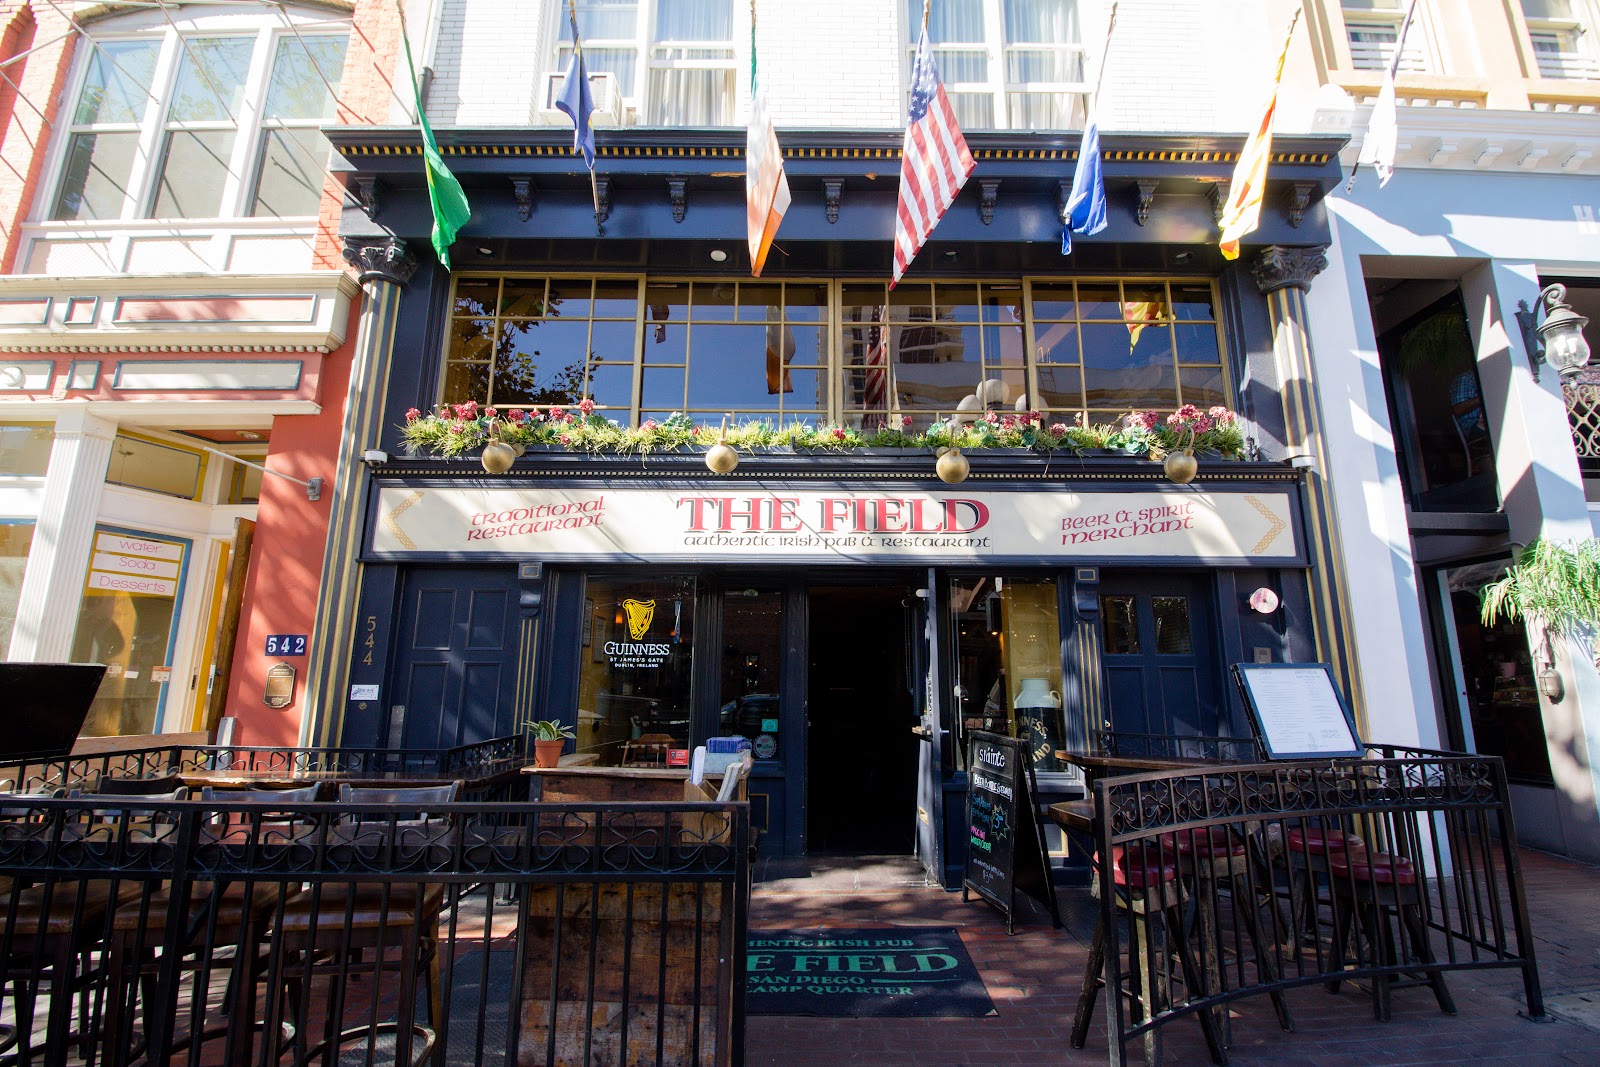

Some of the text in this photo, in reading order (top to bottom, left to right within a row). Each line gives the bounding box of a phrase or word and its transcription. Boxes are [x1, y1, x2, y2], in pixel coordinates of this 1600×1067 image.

[471, 496, 606, 526] traditional
[676, 497, 990, 535] THE FIELD
[1115, 510, 1133, 523] &
[467, 512, 605, 541] restaurant
[1061, 515, 1194, 545] merchant
[684, 534, 775, 547] authentic
[861, 536, 877, 547] &
[881, 536, 990, 548] restaurant
[118, 556, 156, 571] Soda
[99, 575, 166, 593] Desserts
[267, 637, 305, 653] 542
[604, 641, 670, 655] GUINNESS
[817, 939, 870, 947] IRISH
[875, 939, 914, 947] PUB
[791, 953, 958, 973] FIELD
[749, 975, 866, 985] SAN DIEGO
[747, 985, 914, 995] AMP QUARTER
